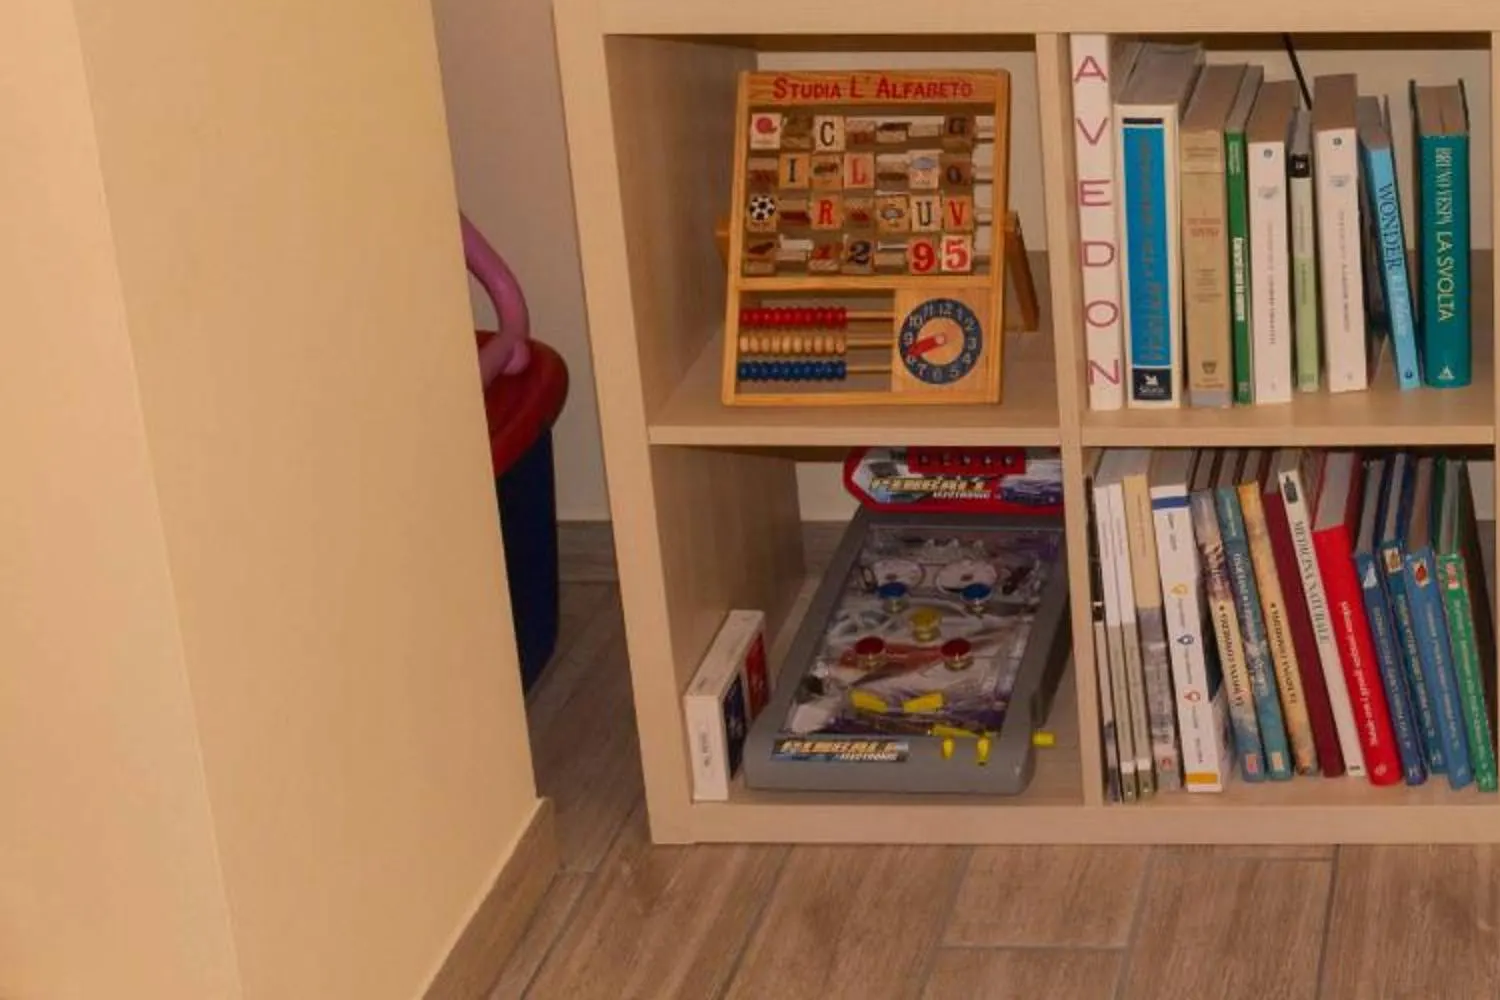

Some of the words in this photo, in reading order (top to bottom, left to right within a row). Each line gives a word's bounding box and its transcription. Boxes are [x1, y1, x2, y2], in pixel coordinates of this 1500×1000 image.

[773, 78, 842, 99] STUDIA
[820, 121, 835, 146] C
[819, 200, 833, 225] R
[917, 202, 932, 226] U
[948, 201, 964, 226] V
[1075, 55, 1121, 386] AVEDON
[1378, 183, 1403, 271] WONDER
[946, 239, 969, 270] 5
[1436, 231, 1454, 253] LA
[912, 242, 936, 272] 9
[1436, 255, 1456, 321] SVOLTA
